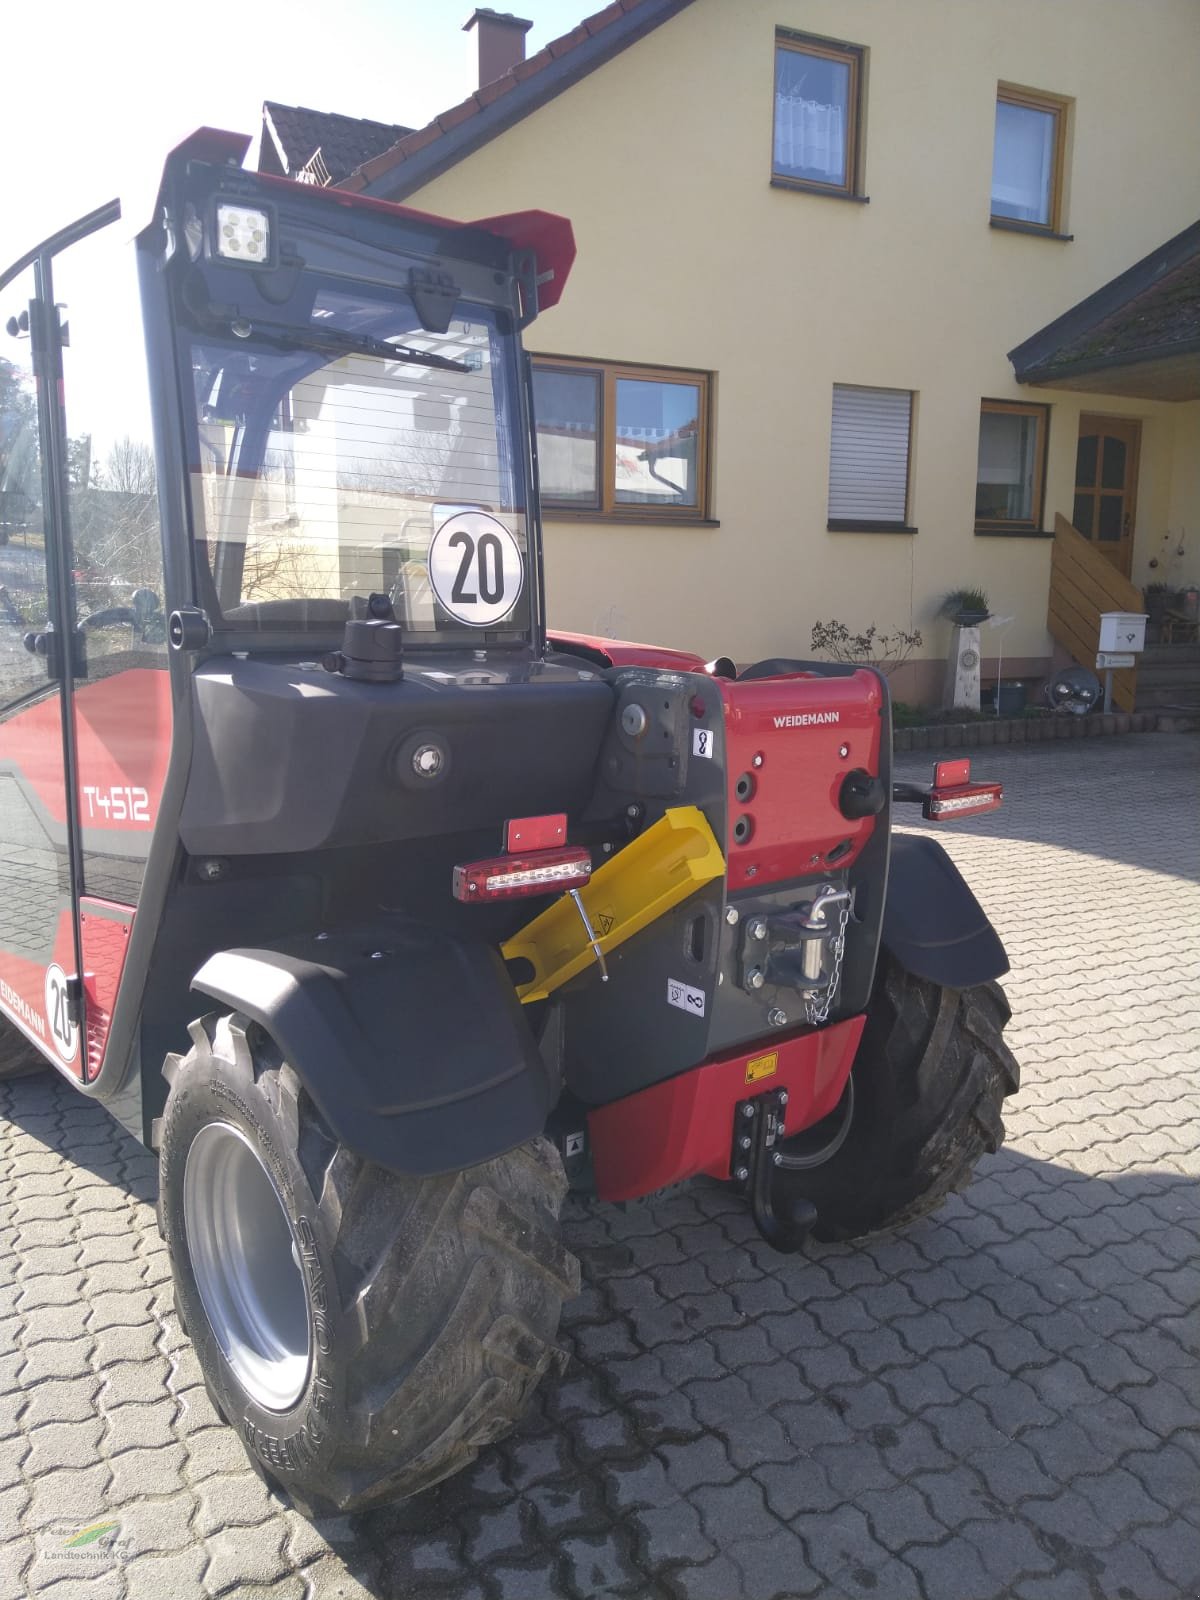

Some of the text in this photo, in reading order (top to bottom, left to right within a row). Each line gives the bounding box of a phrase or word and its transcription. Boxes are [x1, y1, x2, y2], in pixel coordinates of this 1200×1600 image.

[448, 531, 505, 605] 20
[773, 711, 840, 729] WEIDEMANN
[83, 786, 150, 822] T4512
